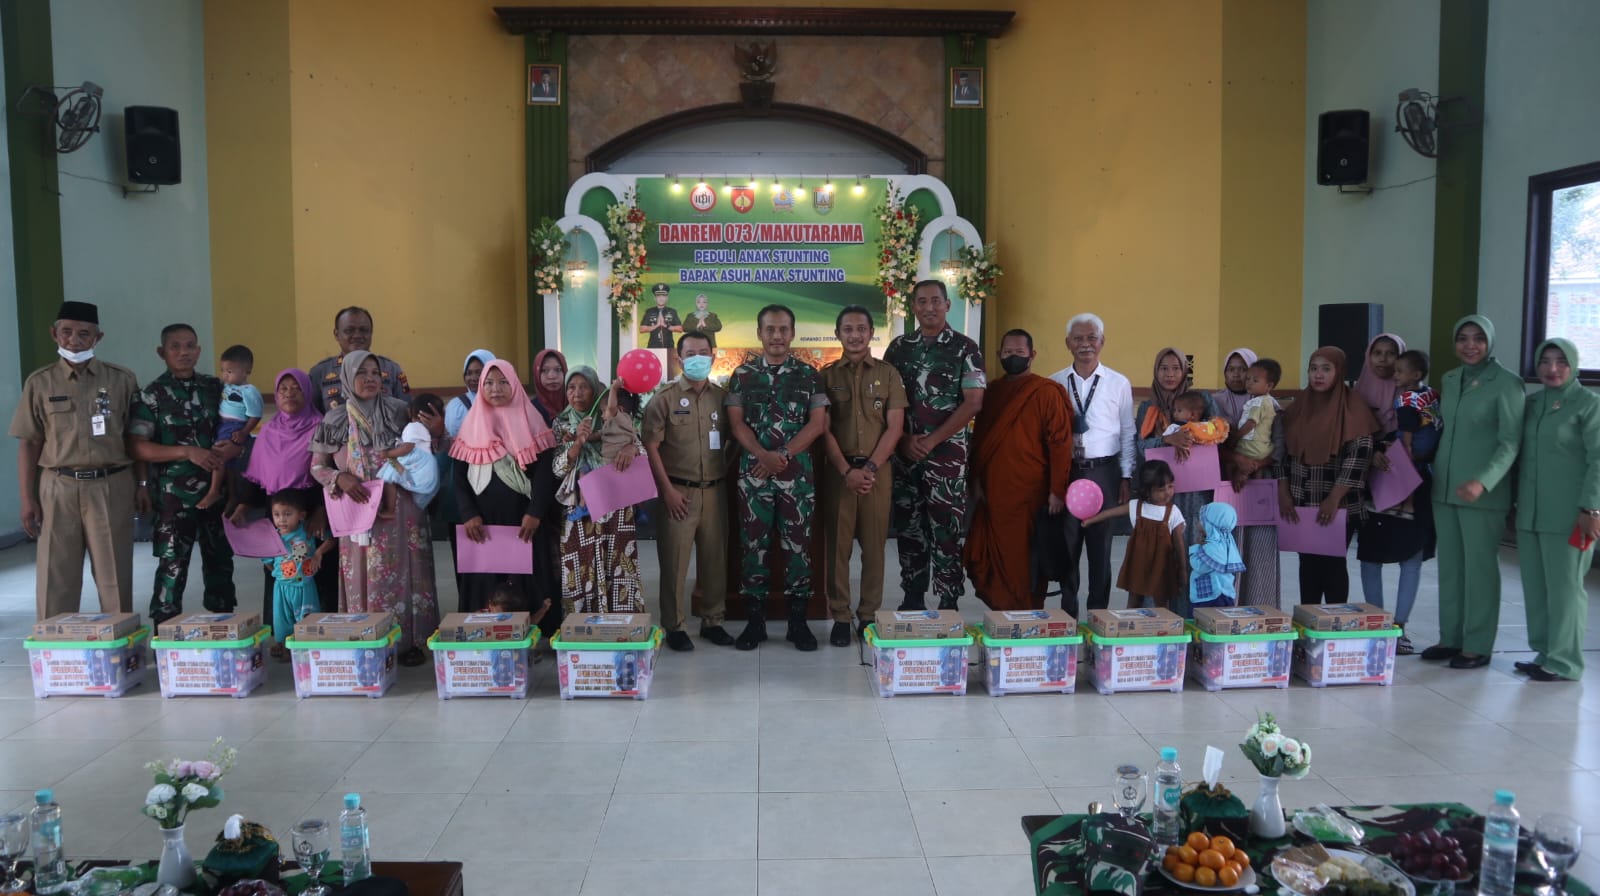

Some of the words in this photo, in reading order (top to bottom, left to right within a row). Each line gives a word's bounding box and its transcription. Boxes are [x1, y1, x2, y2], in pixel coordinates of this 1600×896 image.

[659, 223, 722, 243] DANREM
[724, 223, 864, 243] 073/MAKUTARAMA
[694, 249, 736, 264] PEDULI
[738, 249, 771, 264] ANAK
[772, 249, 830, 264] STUNTING
[680, 268, 718, 283] BAPAK
[720, 268, 752, 283] ASUH
[754, 268, 786, 283] ANAK
[788, 268, 845, 283] STUNTING
